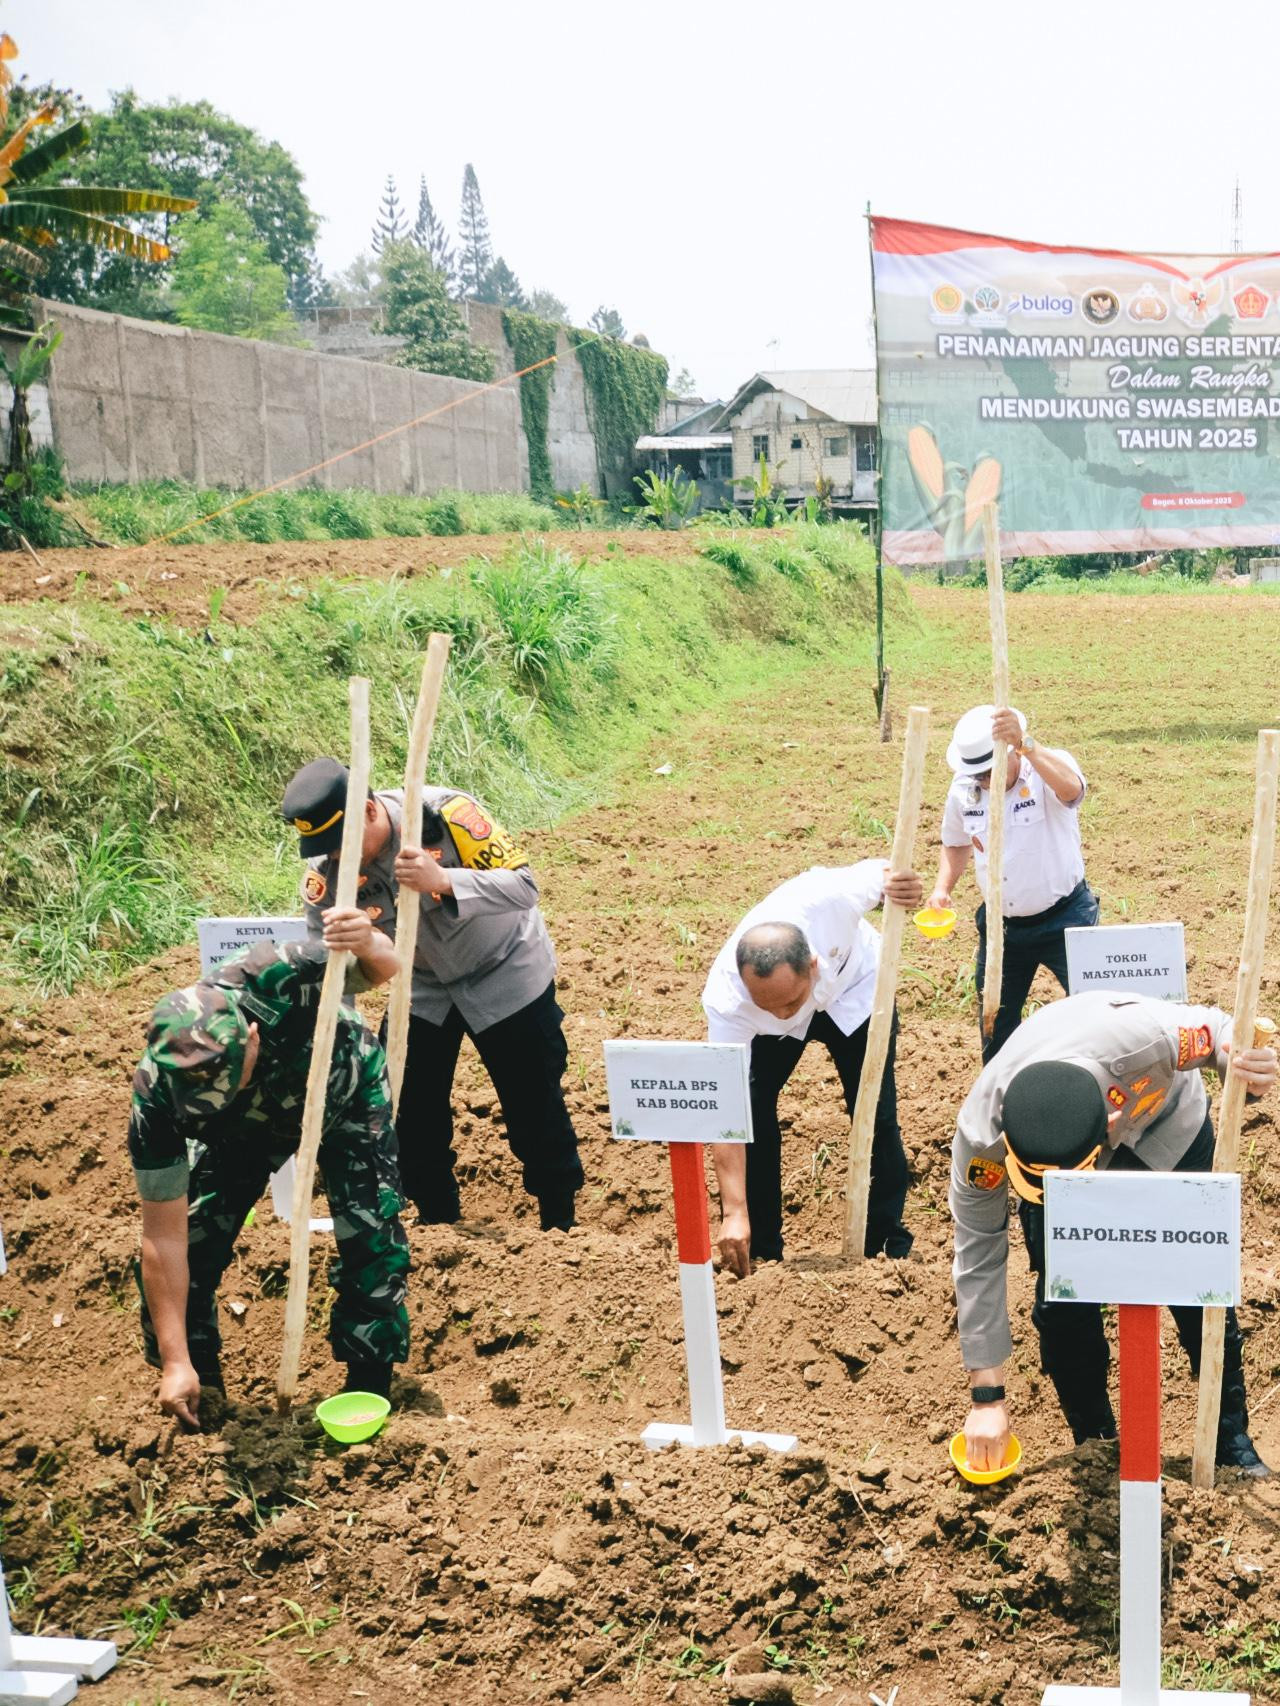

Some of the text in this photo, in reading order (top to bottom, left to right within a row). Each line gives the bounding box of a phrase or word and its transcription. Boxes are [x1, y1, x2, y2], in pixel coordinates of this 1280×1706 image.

[1022, 294, 1073, 315] bulog
[938, 335, 1084, 358] PENANAMAN
[1090, 336, 1180, 358] JAGUNG
[1108, 363, 1271, 394] Dalam Rangka
[981, 398, 1130, 418] MENDUKUNG
[1117, 428, 1258, 449] TAHUN 2025
[236, 927, 274, 936] KETUA
[1106, 953, 1147, 963] TOKOH
[1082, 967, 1170, 980] MASYARAKAT
[630, 1079, 718, 1091] KEPALA BPS
[636, 1098, 719, 1110] KAB BOGOR
[1052, 1227, 1230, 1245] KAPOLRES BOGOR
